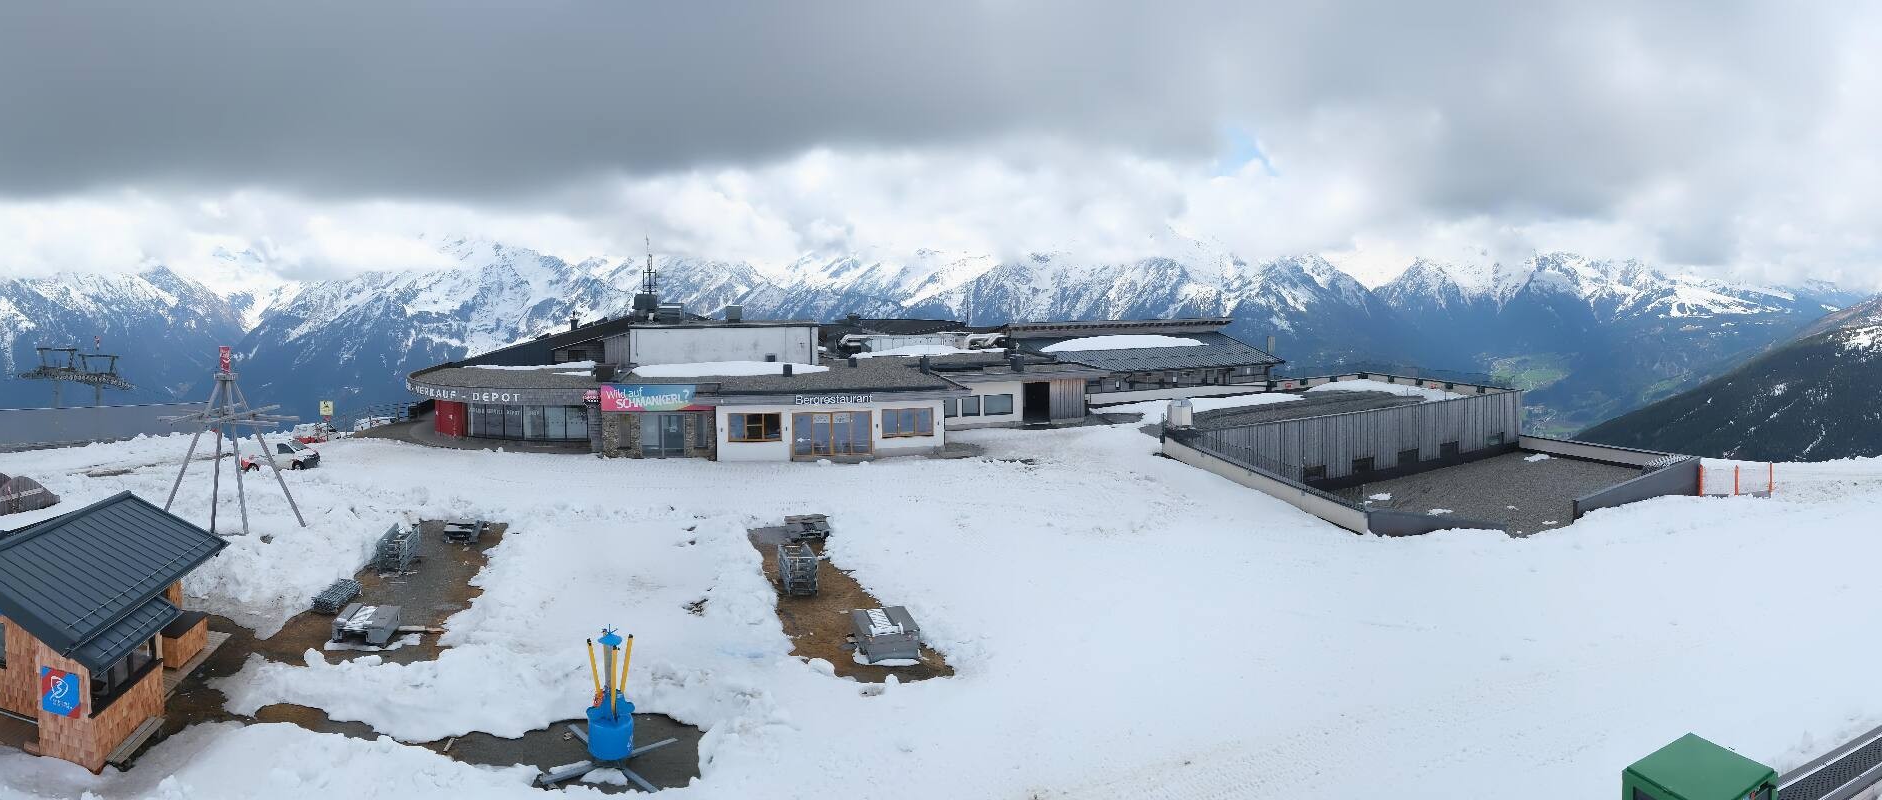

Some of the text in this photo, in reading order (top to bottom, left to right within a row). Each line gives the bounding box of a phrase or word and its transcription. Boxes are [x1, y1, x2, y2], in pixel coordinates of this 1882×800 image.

[415, 385, 457, 399] VERKAUF
[472, 392, 521, 402] DEPOT
[606, 388, 626, 400] Wild
[628, 387, 643, 398] auf
[795, 394, 873, 406] Bergrestaurant
